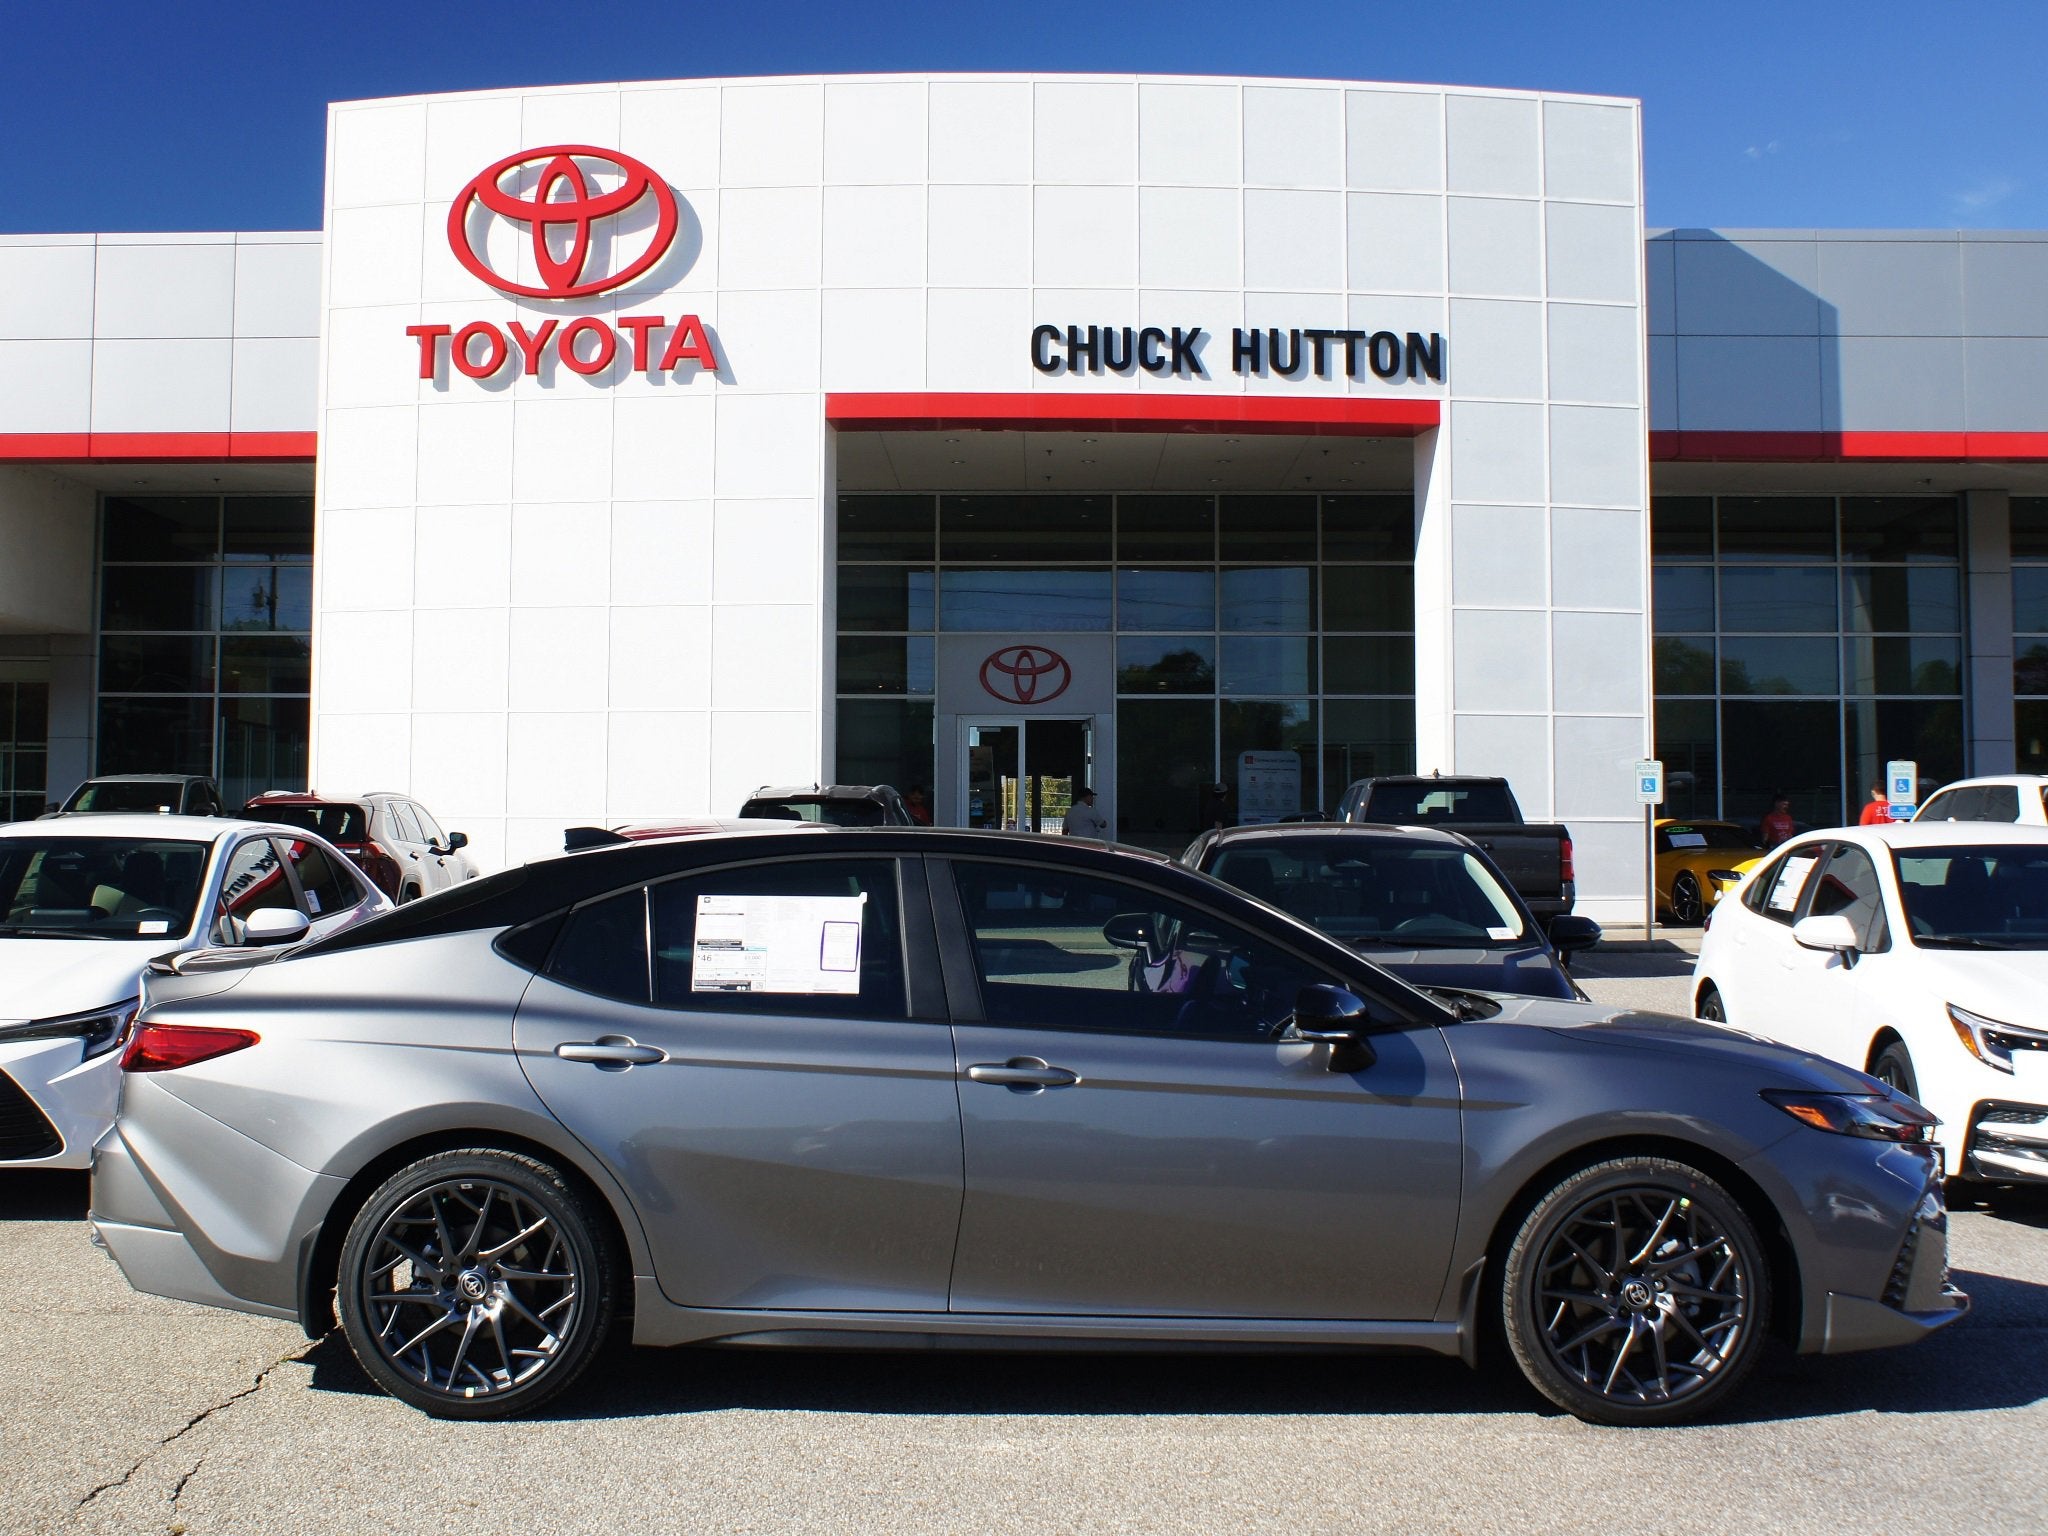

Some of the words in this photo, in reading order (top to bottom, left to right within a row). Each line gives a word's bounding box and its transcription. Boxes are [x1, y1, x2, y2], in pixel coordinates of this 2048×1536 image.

[406, 315, 718, 379] TOYOTA
[1031, 325, 1203, 374] CHUCK
[1232, 328, 1441, 381] HUTTON
